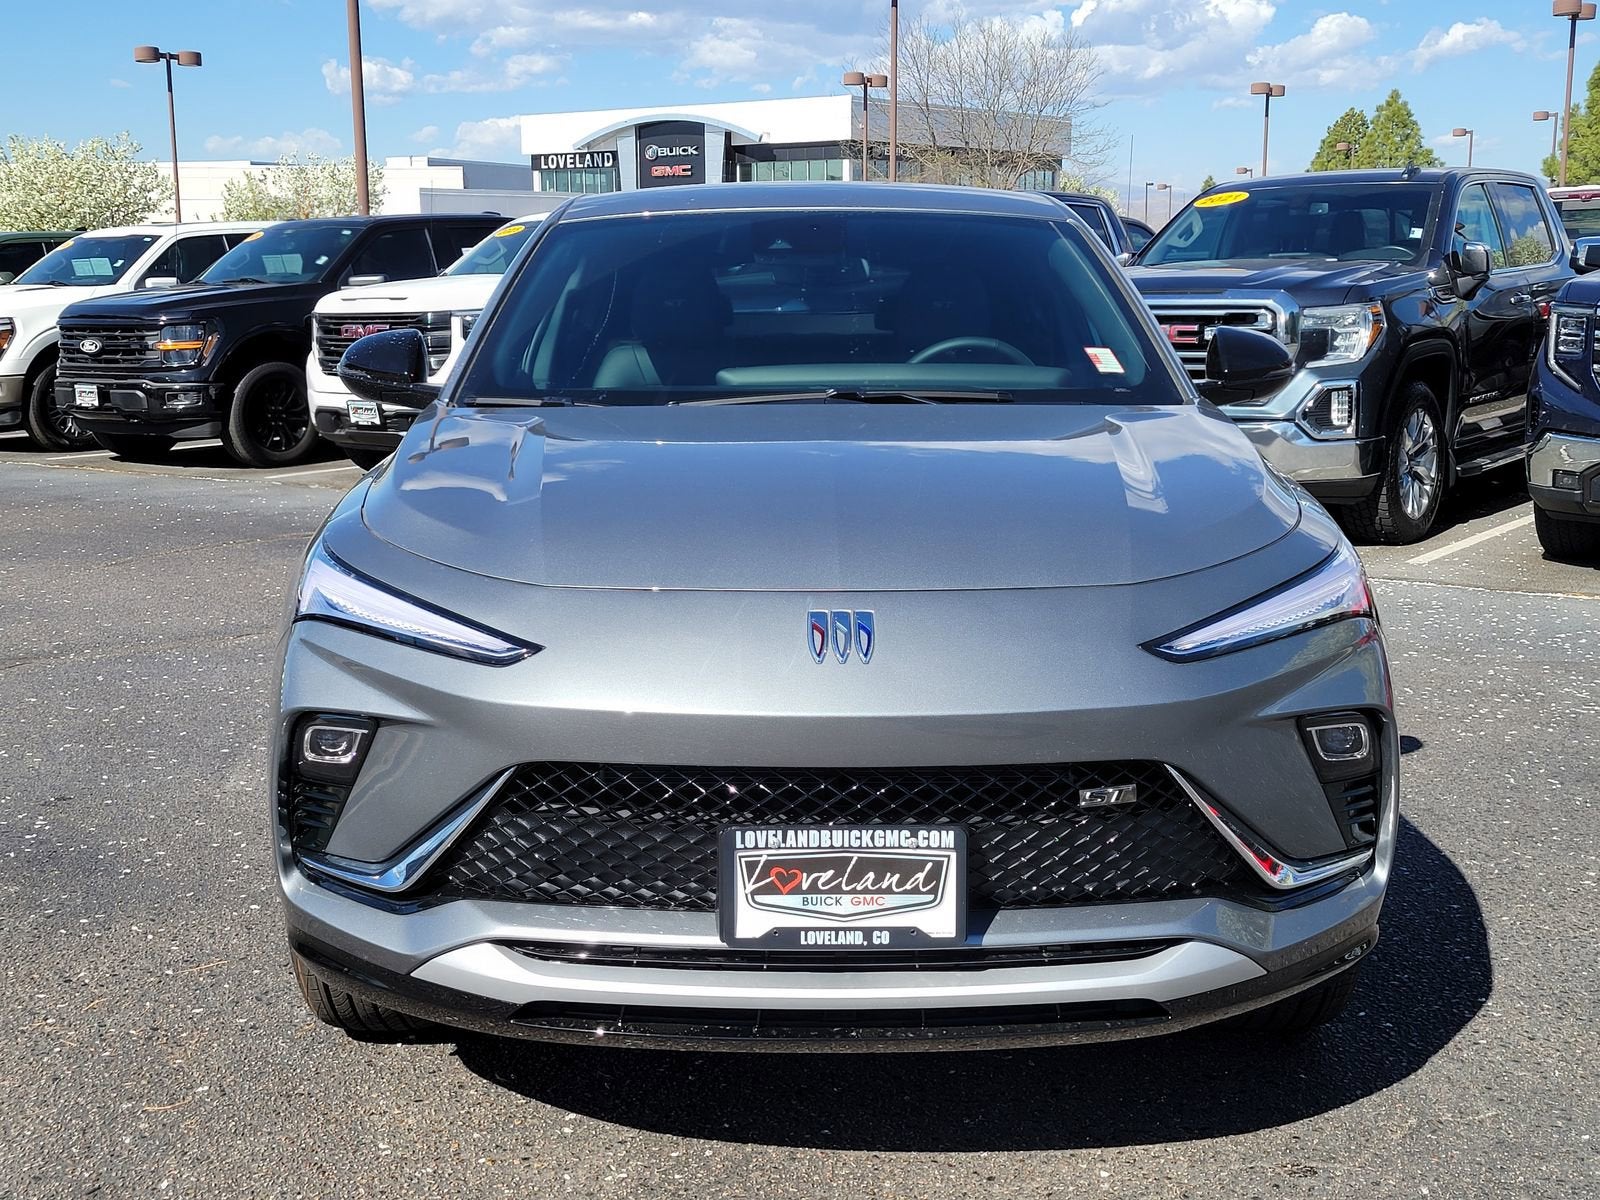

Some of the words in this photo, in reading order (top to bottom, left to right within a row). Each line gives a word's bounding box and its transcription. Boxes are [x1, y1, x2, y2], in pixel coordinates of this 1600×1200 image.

[658, 146, 699, 156] BUICK
[541, 153, 613, 169] LOVELAND
[651, 165, 692, 177] GMC
[735, 829, 955, 849] LOVELANDBUICKGMCCOM
[802, 896, 843, 906] BUICK
[850, 896, 886, 906] GMC
[800, 930, 868, 946] LOVELAND,
[872, 930, 890, 945] CO
